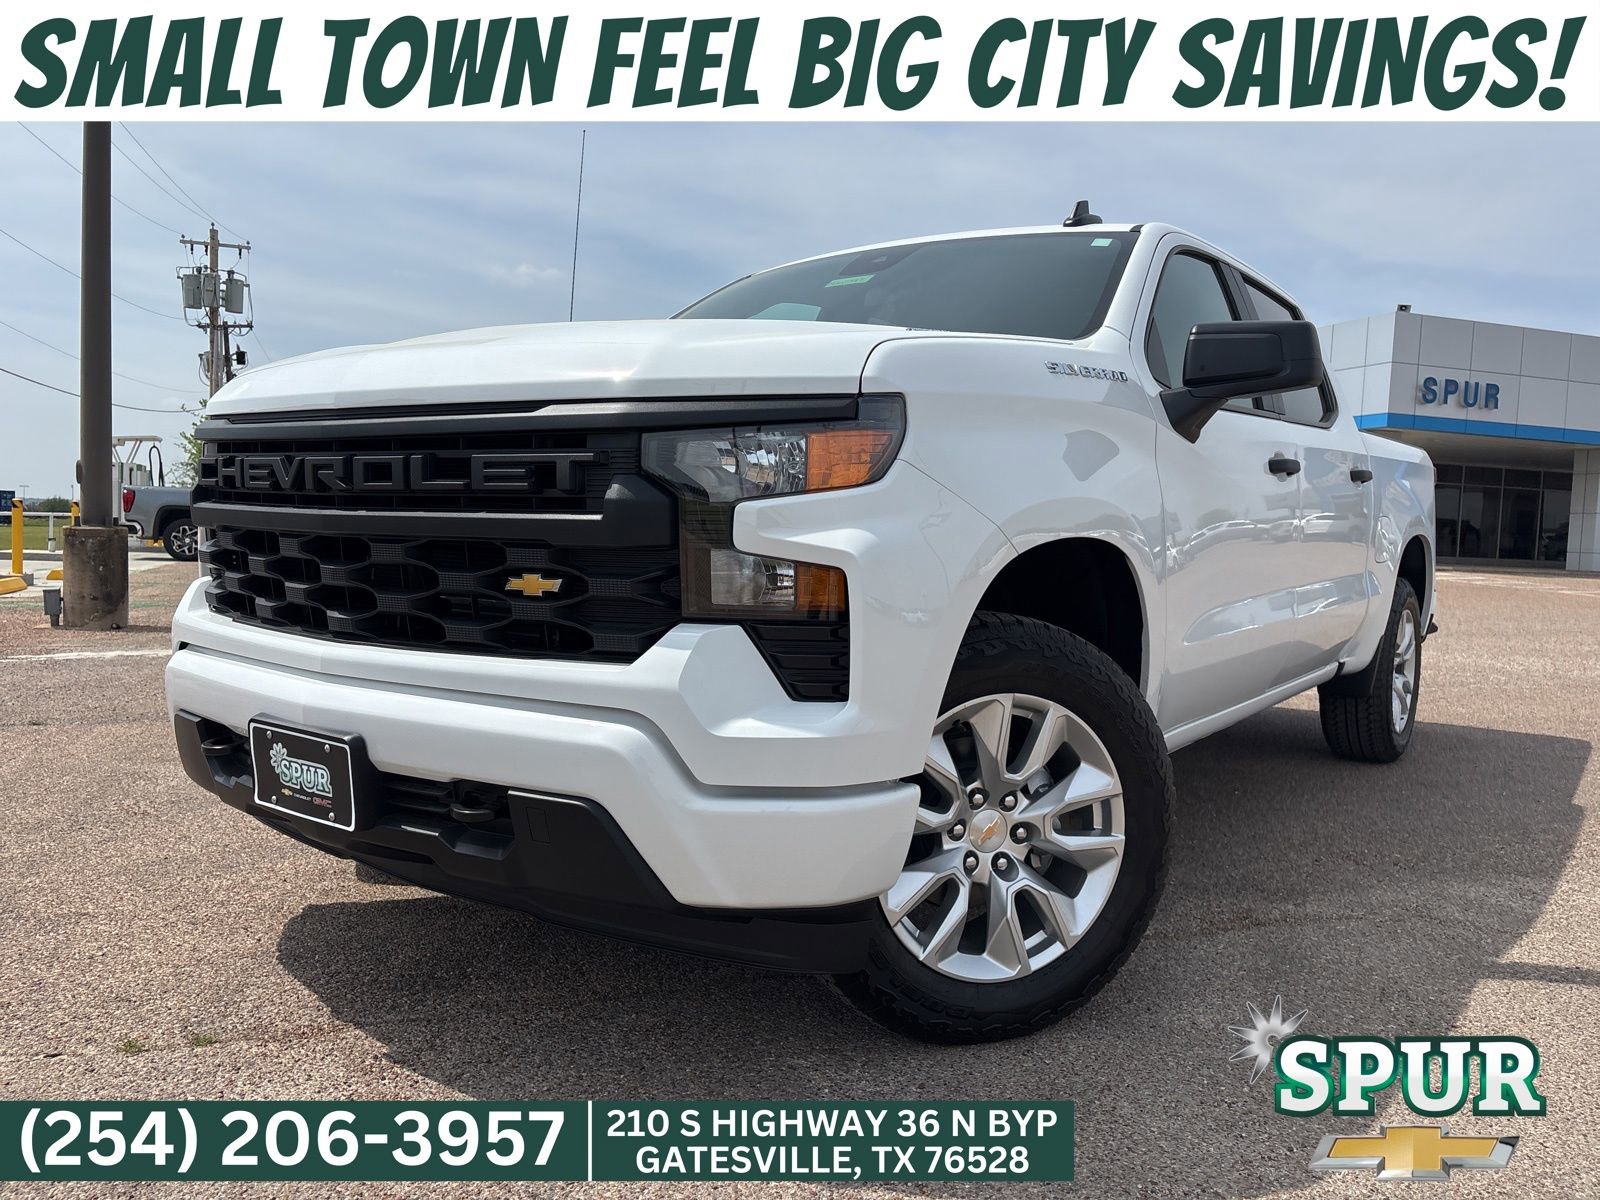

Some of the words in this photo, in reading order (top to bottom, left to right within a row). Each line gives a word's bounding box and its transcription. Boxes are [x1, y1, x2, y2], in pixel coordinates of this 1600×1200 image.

[1421, 376, 1501, 410] SPUR
[199, 451, 610, 494] CHEVROLET
[280, 758, 332, 795] SPUR
[312, 797, 332, 808] GMC
